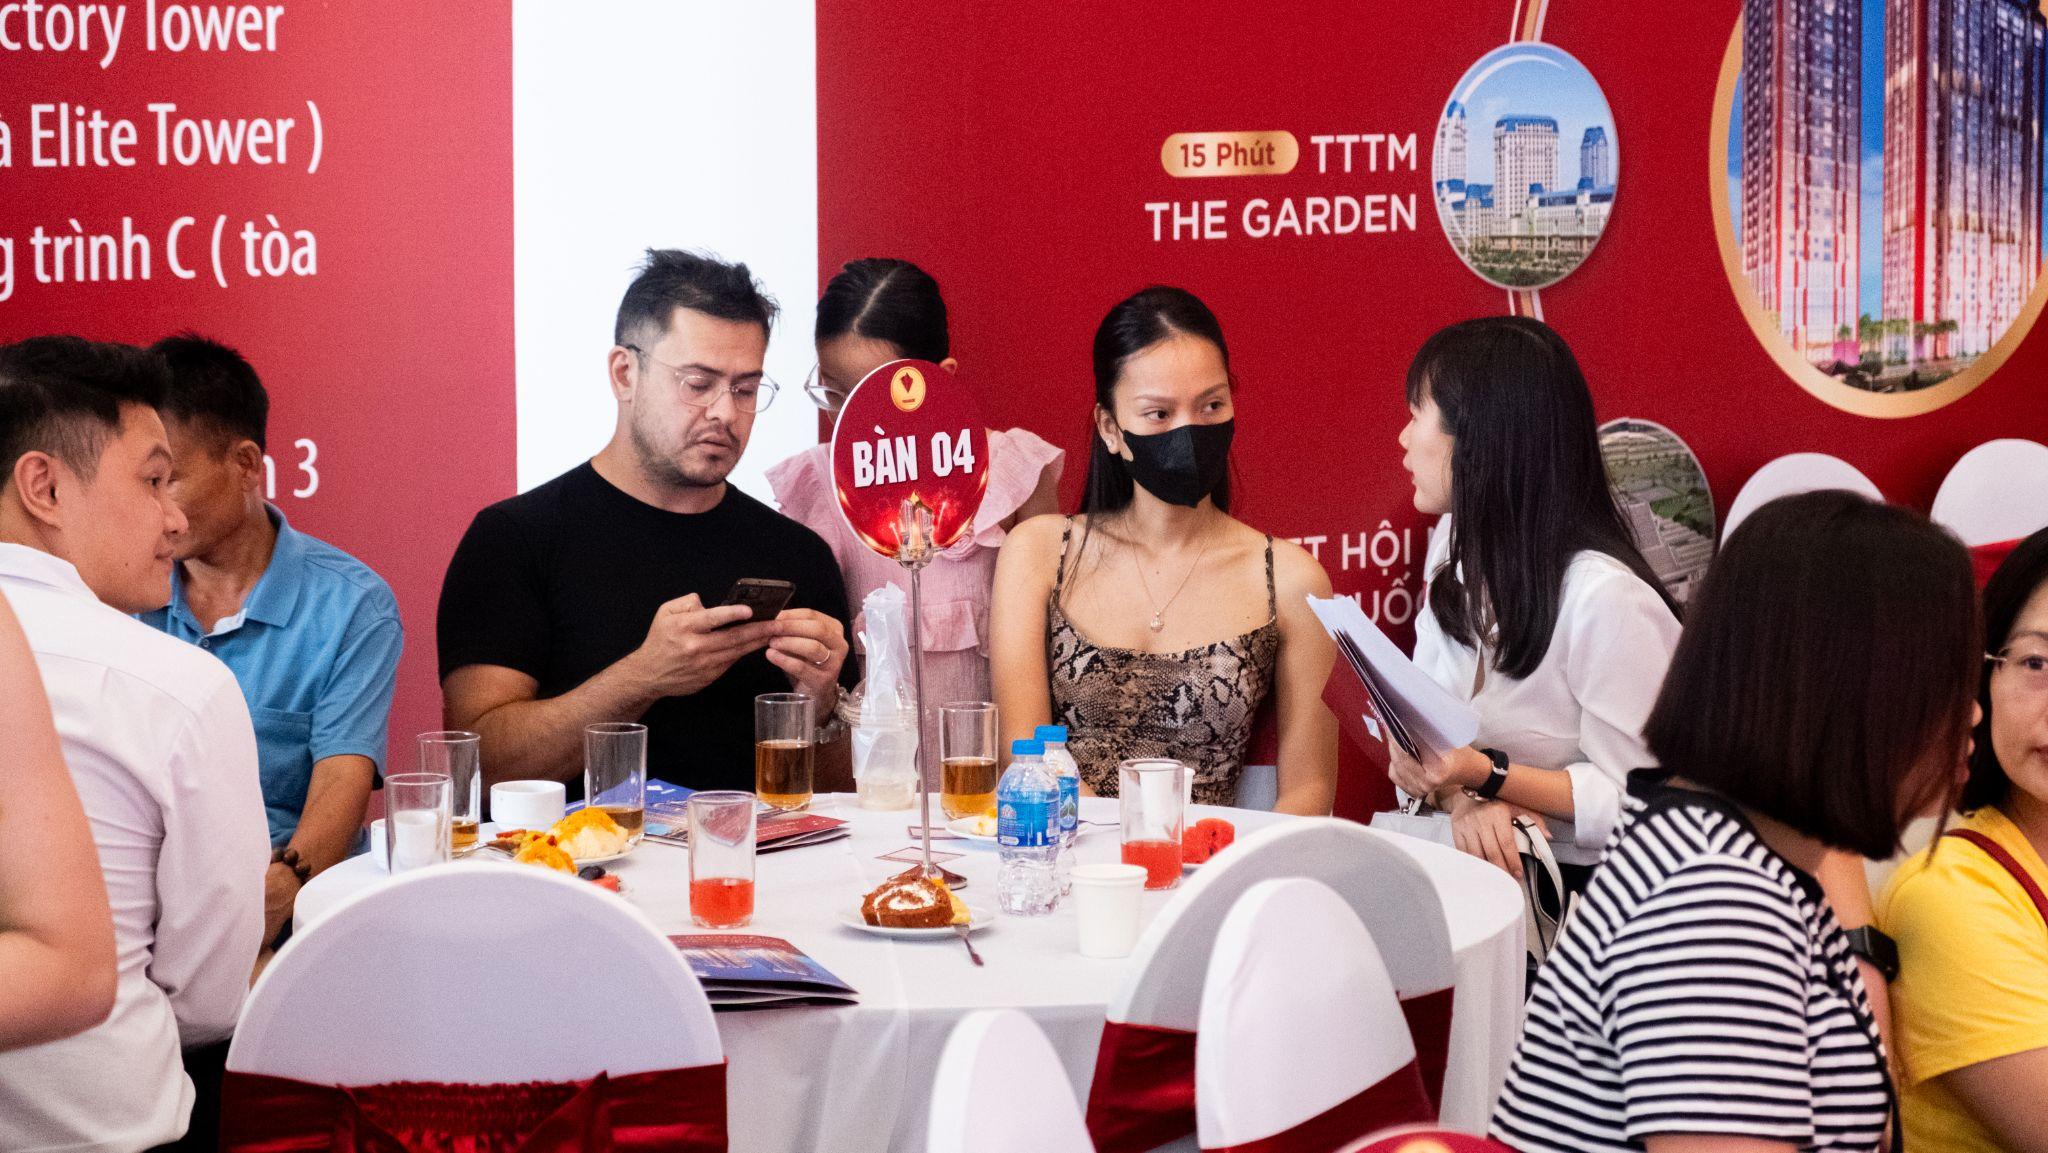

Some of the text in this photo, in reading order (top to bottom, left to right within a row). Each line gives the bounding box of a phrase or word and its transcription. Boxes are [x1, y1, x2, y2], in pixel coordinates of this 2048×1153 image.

[31, 102, 137, 167] Elite
[148, 103, 295, 166] Tower
[307, 101, 322, 173] )
[1181, 139, 1275, 167] 15 Phút
[1311, 133, 1416, 173] TTTM
[1145, 194, 1416, 241] THE GARDEN
[30, 217, 150, 283] trình
[167, 216, 196, 279] C
[211, 215, 227, 288] (
[241, 214, 317, 277] tòa
[294, 438, 319, 498] 3
[852, 425, 975, 488] BÀN 04
[1341, 519, 1411, 576] HỘI
